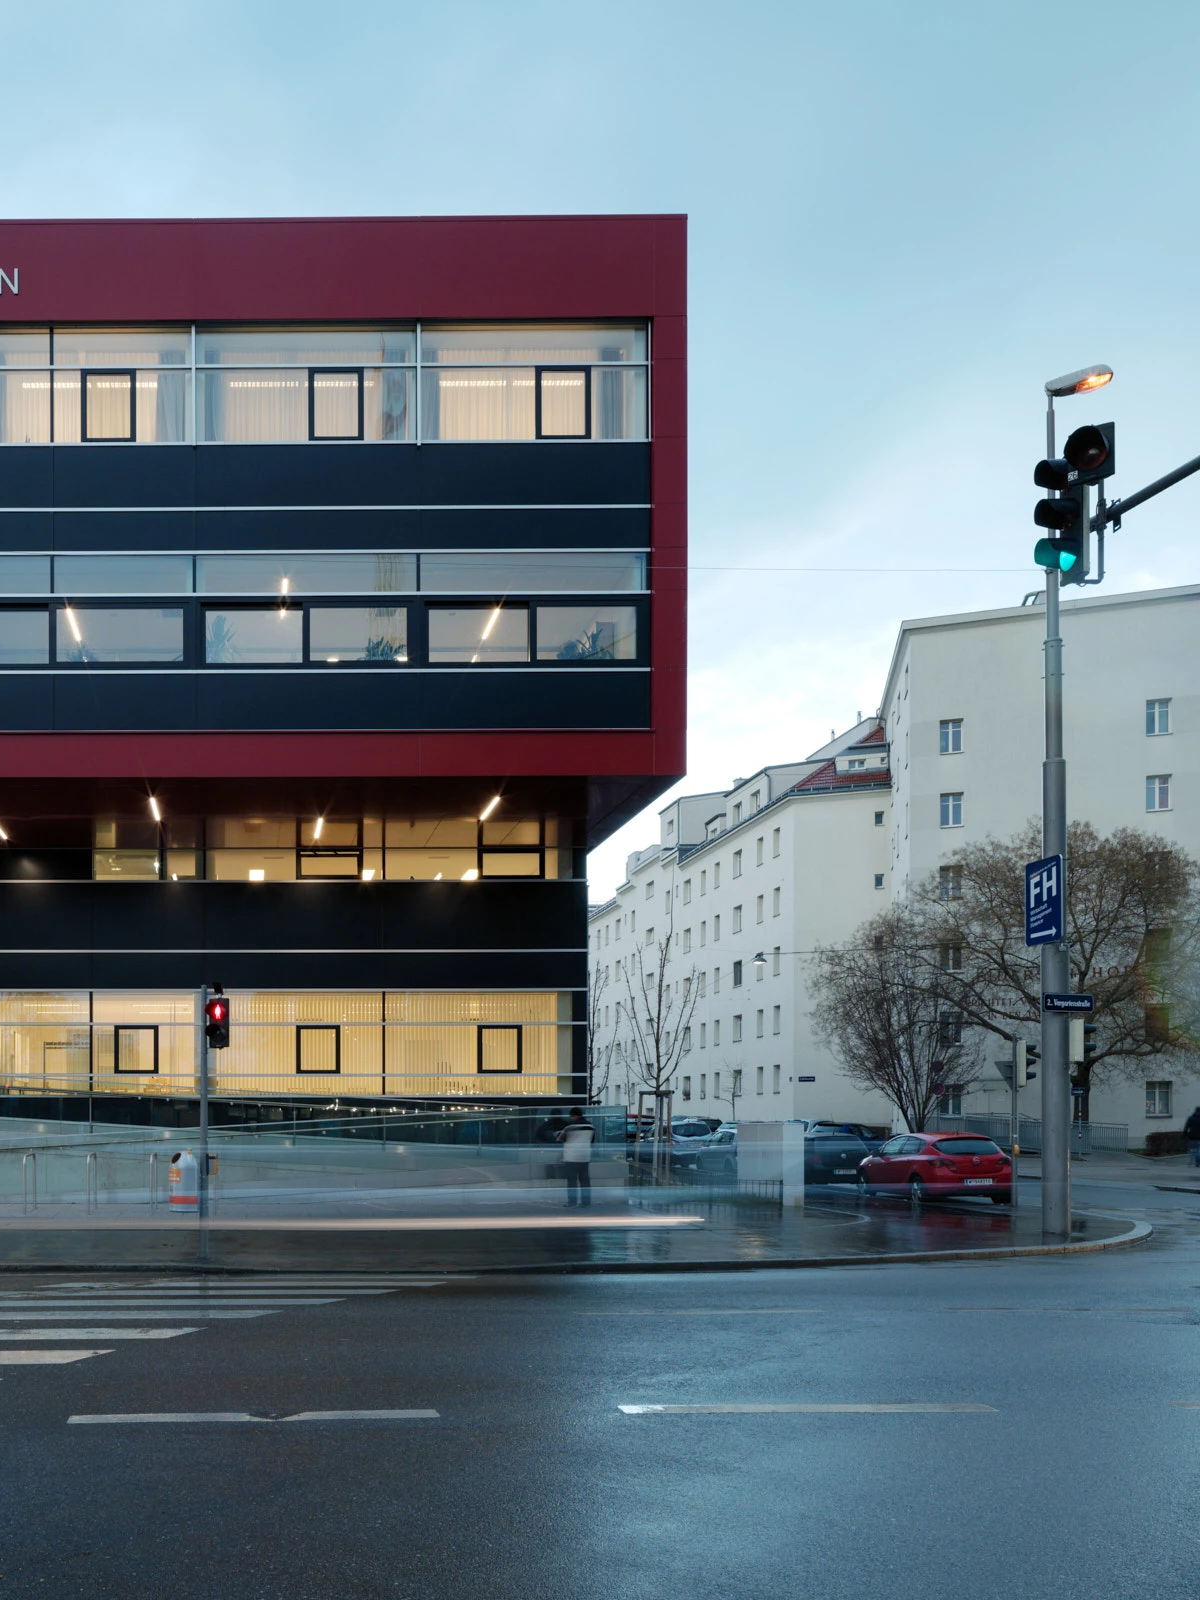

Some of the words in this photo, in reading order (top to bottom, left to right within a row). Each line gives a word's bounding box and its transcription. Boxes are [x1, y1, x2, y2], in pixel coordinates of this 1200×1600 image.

[1029, 866, 1057, 909] FH
[1029, 907, 1053, 922] Management
[1053, 998, 1091, 1009] Vorgartenstraße
